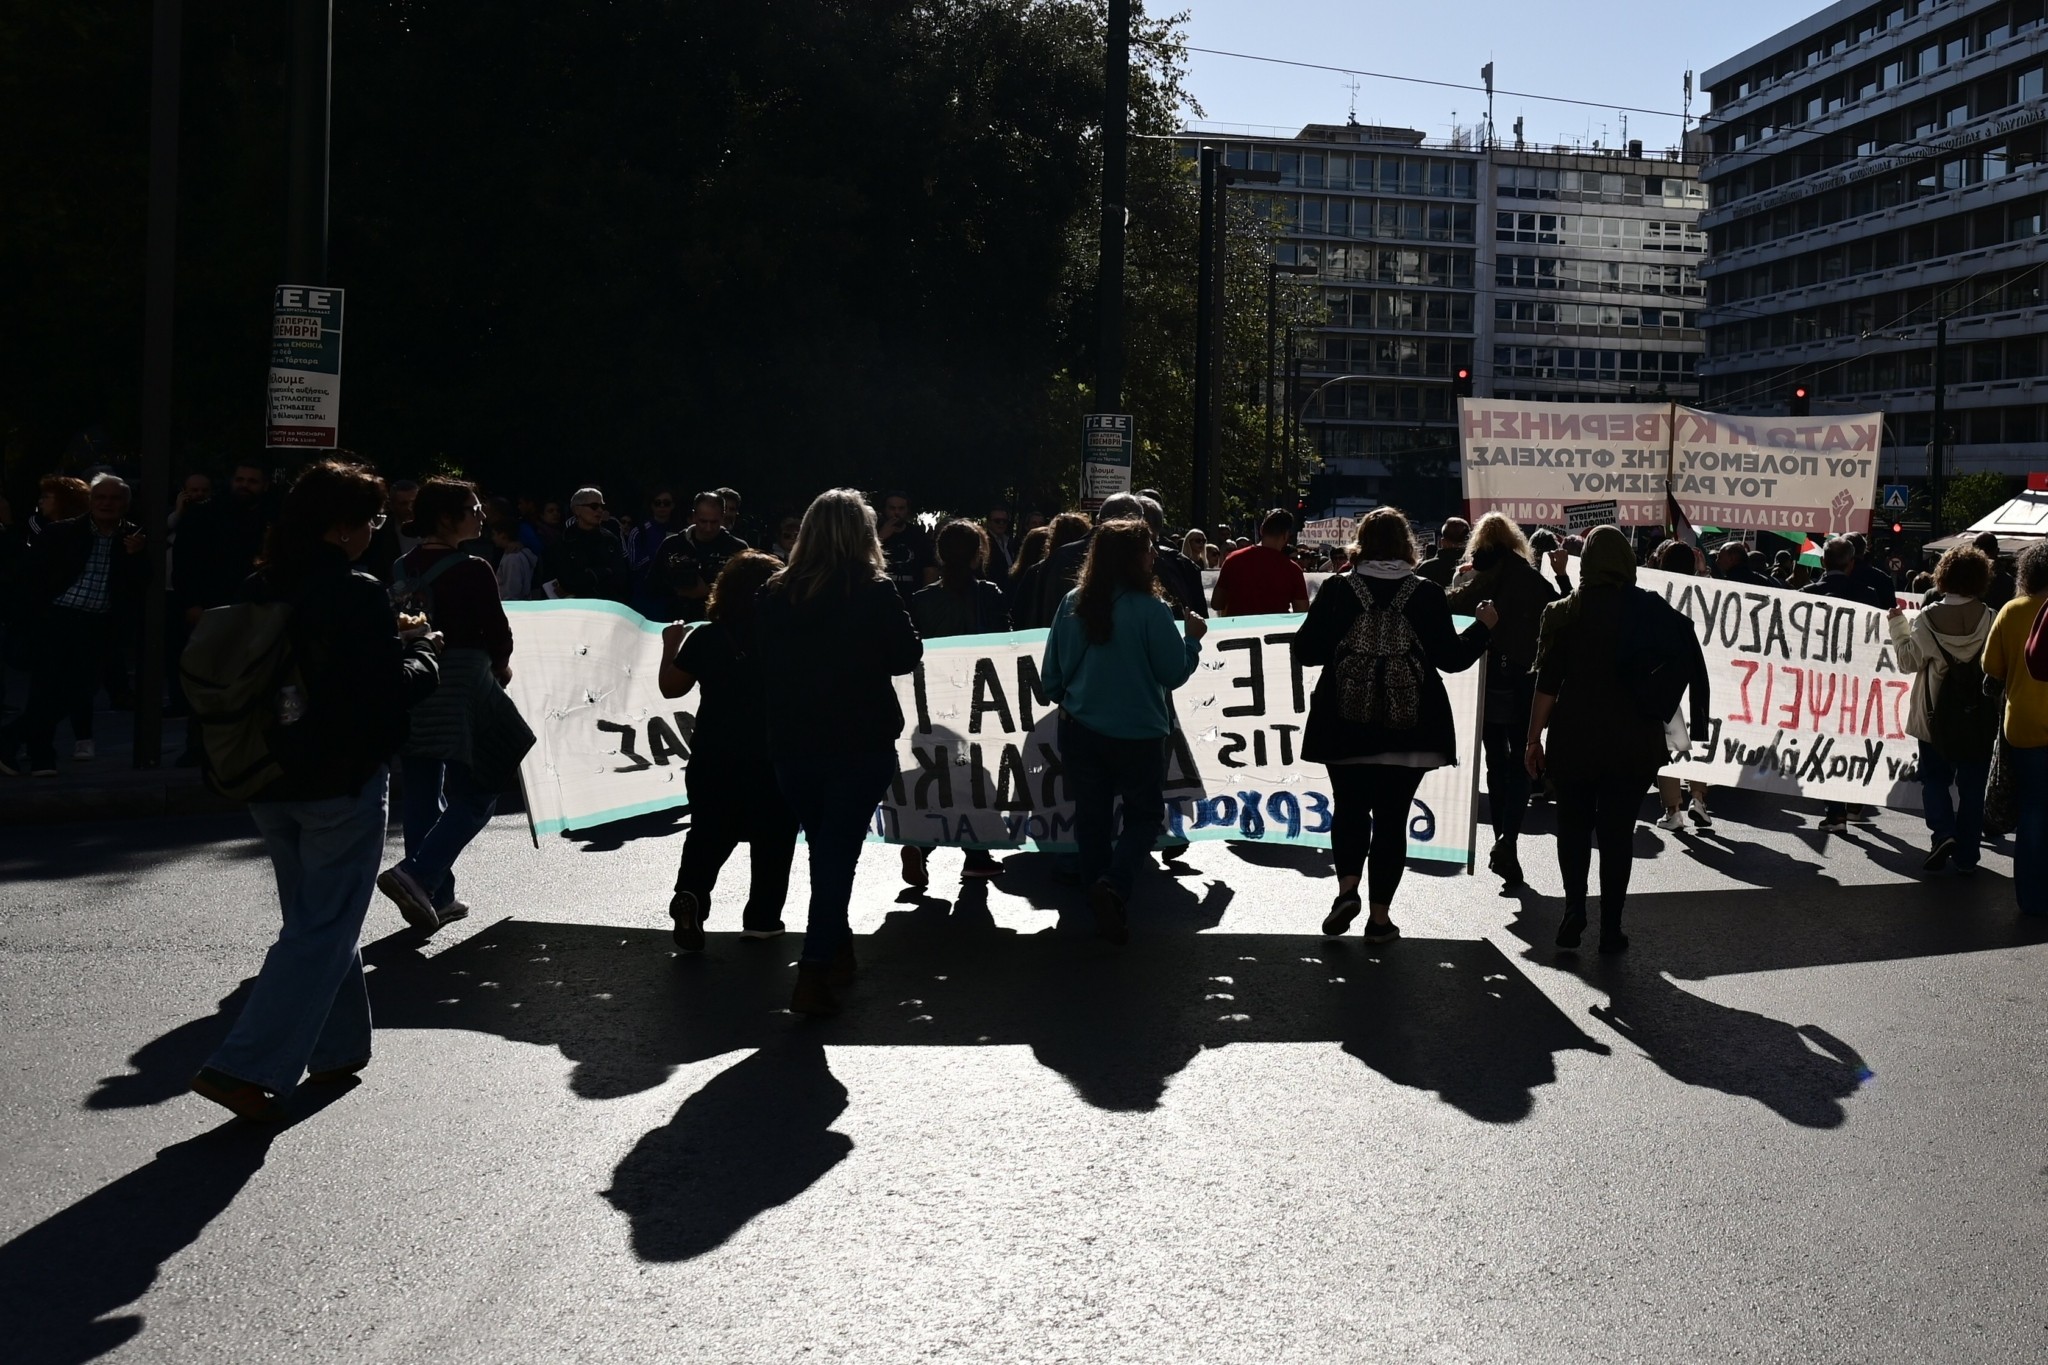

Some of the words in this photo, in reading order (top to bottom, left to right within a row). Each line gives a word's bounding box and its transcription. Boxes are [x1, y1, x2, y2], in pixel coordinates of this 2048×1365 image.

[276, 288, 331, 310] ΕΕ
[1086, 416, 1127, 429] ΓΣΕΕ
[1569, 509, 1614, 522] ΚΥΒΕΡΝΗΣΗ
